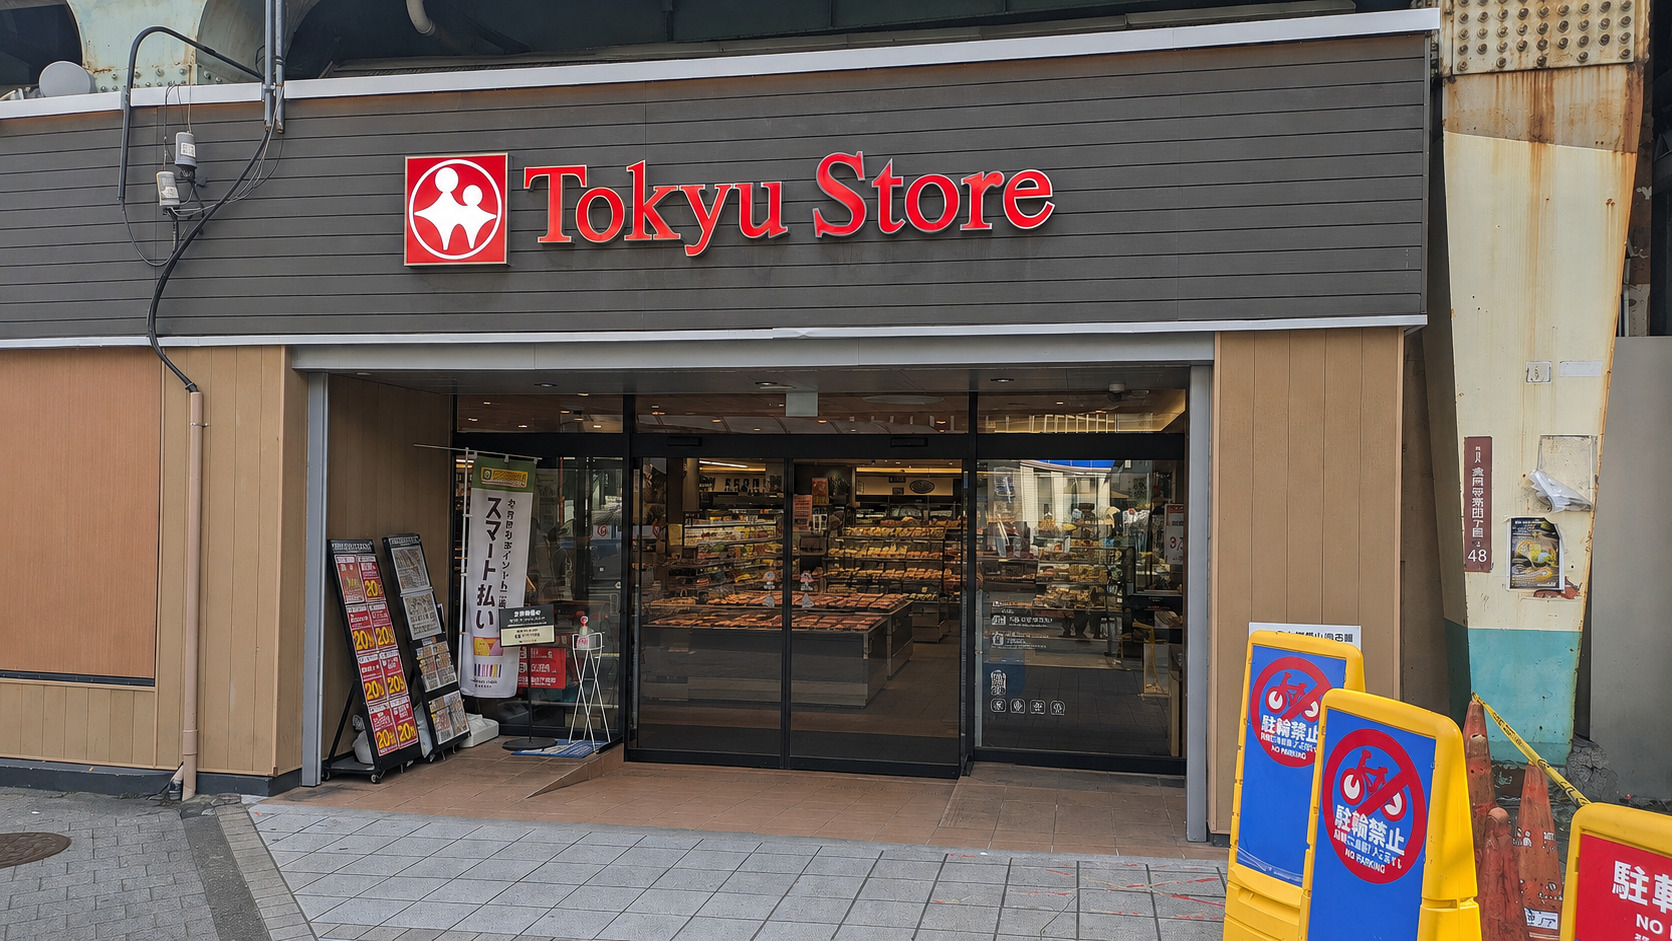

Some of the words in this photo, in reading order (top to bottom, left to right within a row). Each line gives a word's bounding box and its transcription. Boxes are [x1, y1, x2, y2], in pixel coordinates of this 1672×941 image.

[523, 159, 788, 257] Tokyu
[812, 151, 1056, 238] Store
[476, 497, 502, 629] スマート払い
[1467, 549, 1487, 562] 48
[1260, 715, 1318, 743] 駐輪禁止
[1334, 804, 1405, 856] 駐輪禁止
[1636, 913, 1664, 934] NO
